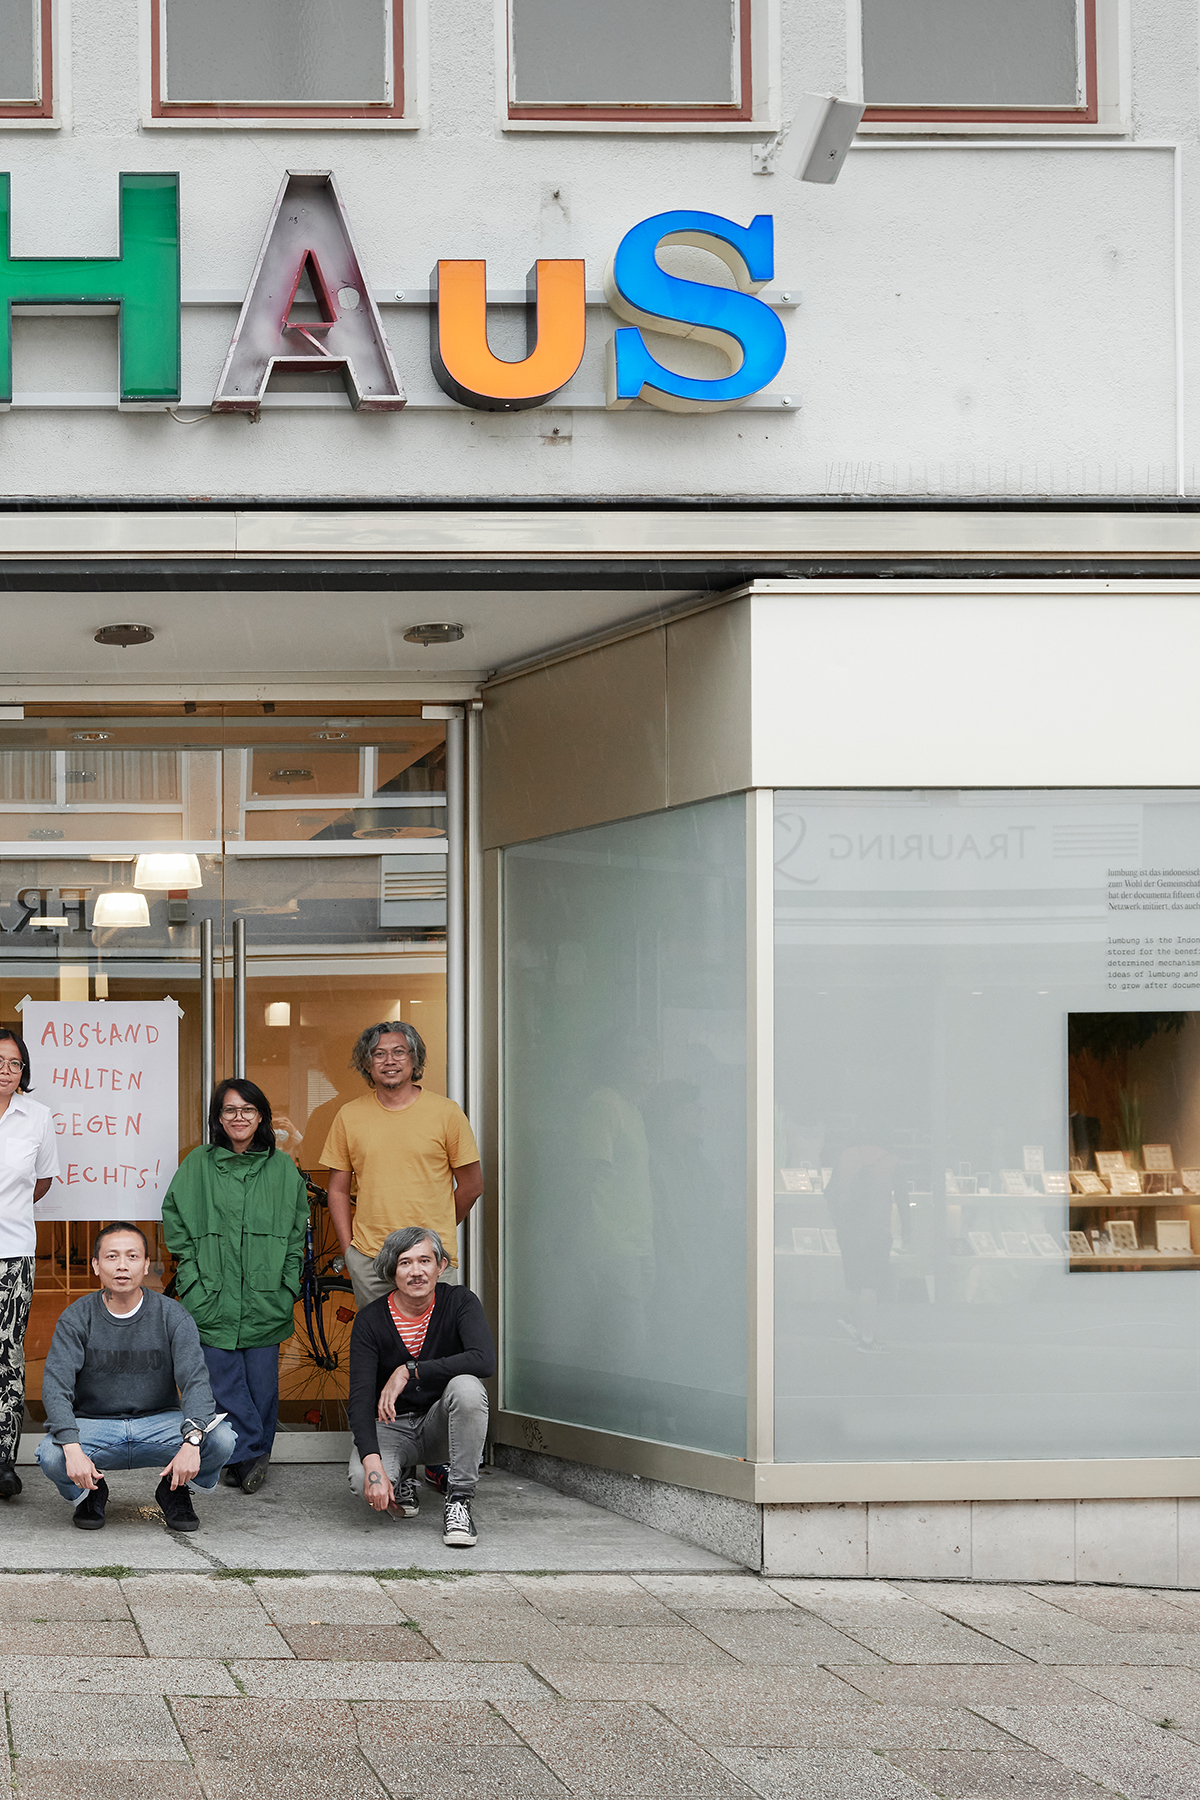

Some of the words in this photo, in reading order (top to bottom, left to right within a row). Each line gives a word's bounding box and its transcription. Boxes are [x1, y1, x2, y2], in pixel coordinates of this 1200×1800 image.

[1108, 868, 1138, 878] lumbung
[1149, 868, 1161, 876] das
[1124, 880, 1142, 888] Wohl
[1144, 880, 1155, 888] der
[1108, 891, 1119, 899] hat
[1121, 891, 1132, 899] der
[1134, 891, 1171, 899] documenta
[1173, 890, 1195, 899] fifteen
[1109, 902, 1141, 911] Netzwerk
[1172, 902, 1183, 910] das
[1108, 937, 1140, 946] lumbung
[1108, 948, 1135, 956] stored
[1148, 971, 1180, 979] lumbung
[1121, 983, 1140, 991] grow
[52, 1067, 143, 1091] HALTEN
